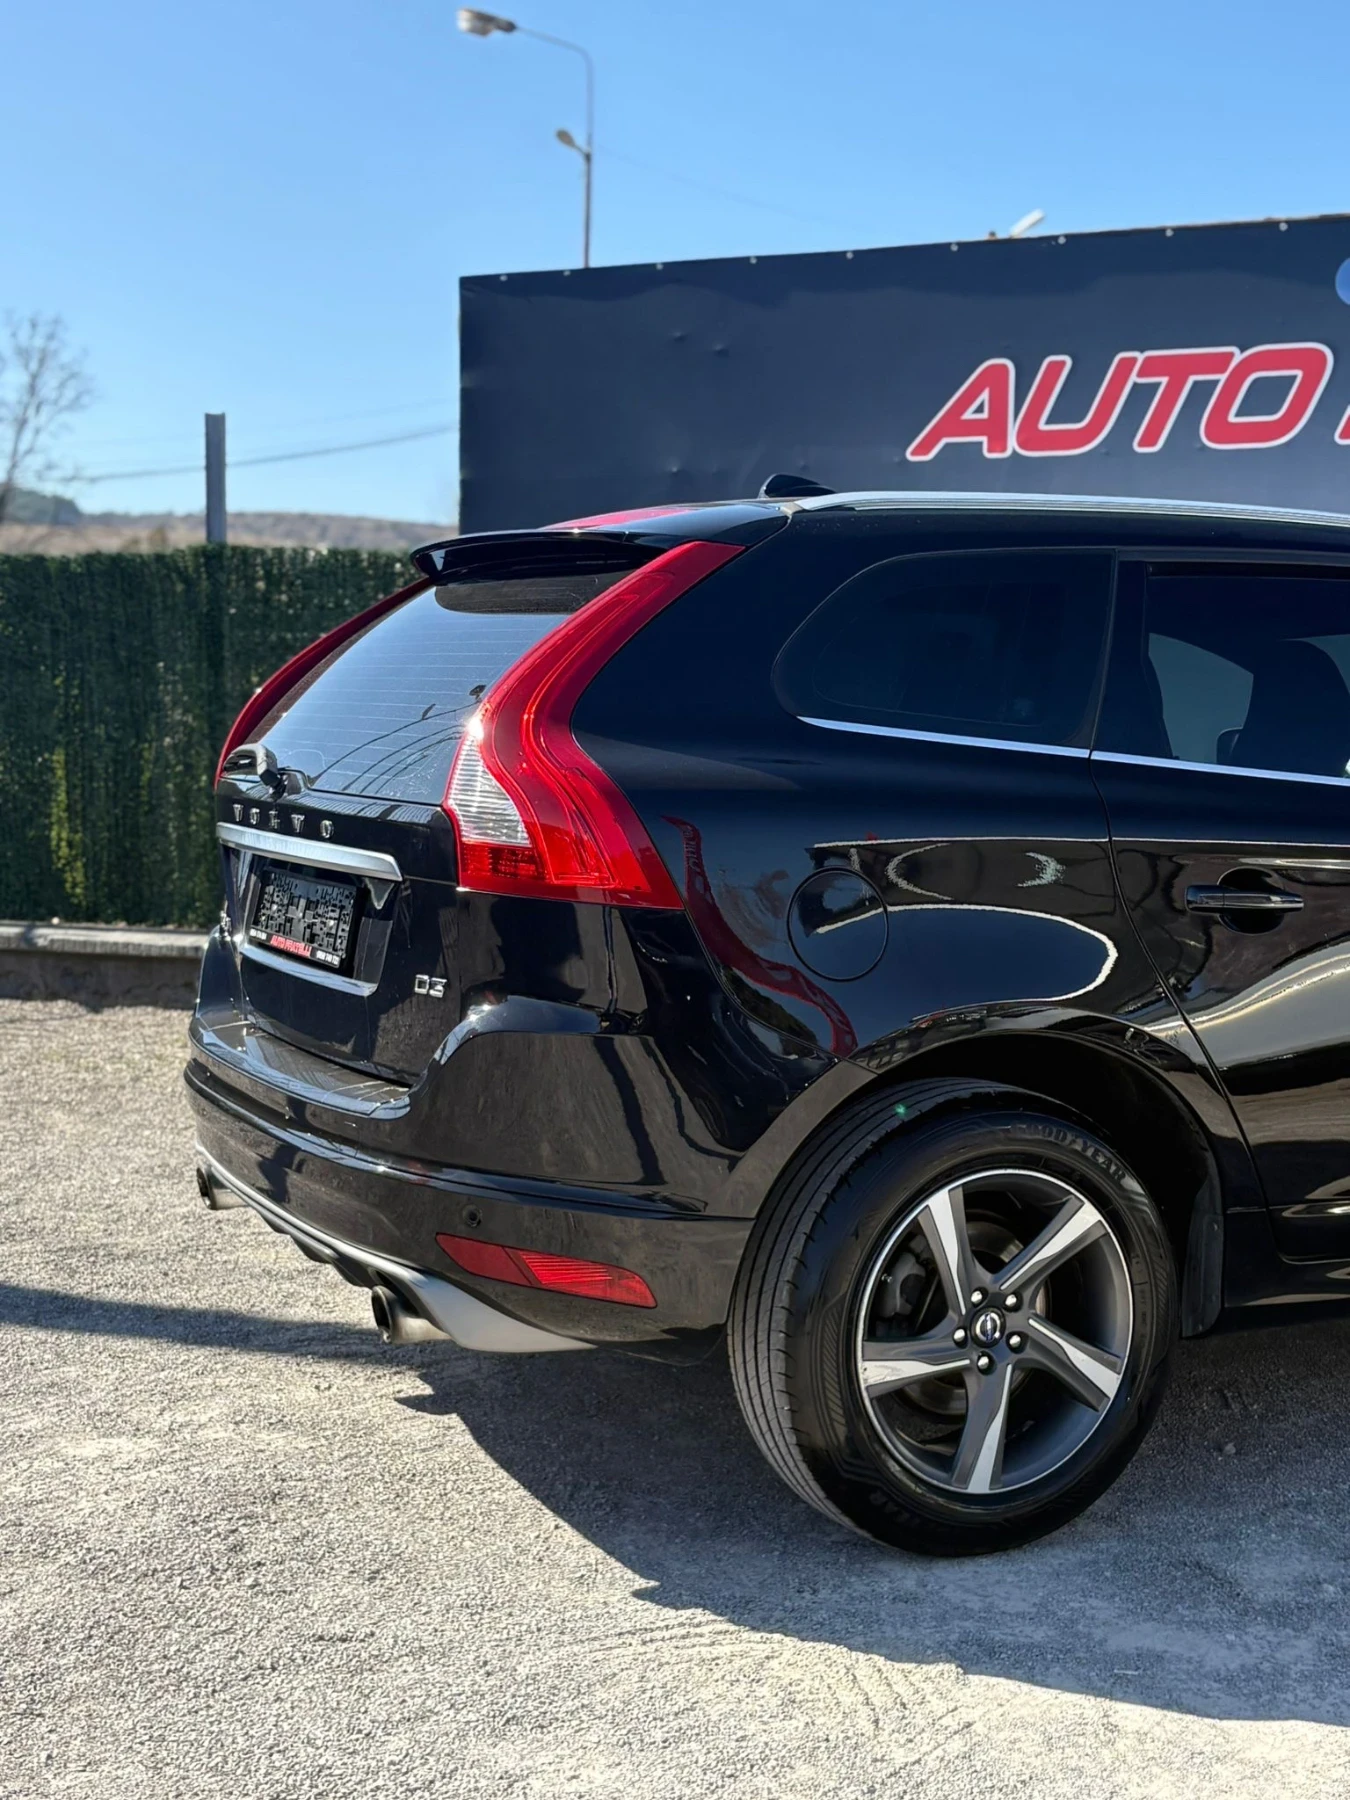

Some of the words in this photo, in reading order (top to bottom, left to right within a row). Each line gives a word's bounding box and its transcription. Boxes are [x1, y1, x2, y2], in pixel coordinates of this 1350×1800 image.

[906, 341, 1334, 461] AUTO
[233, 804, 334, 838] VOLVO
[415, 974, 448, 998] D3
